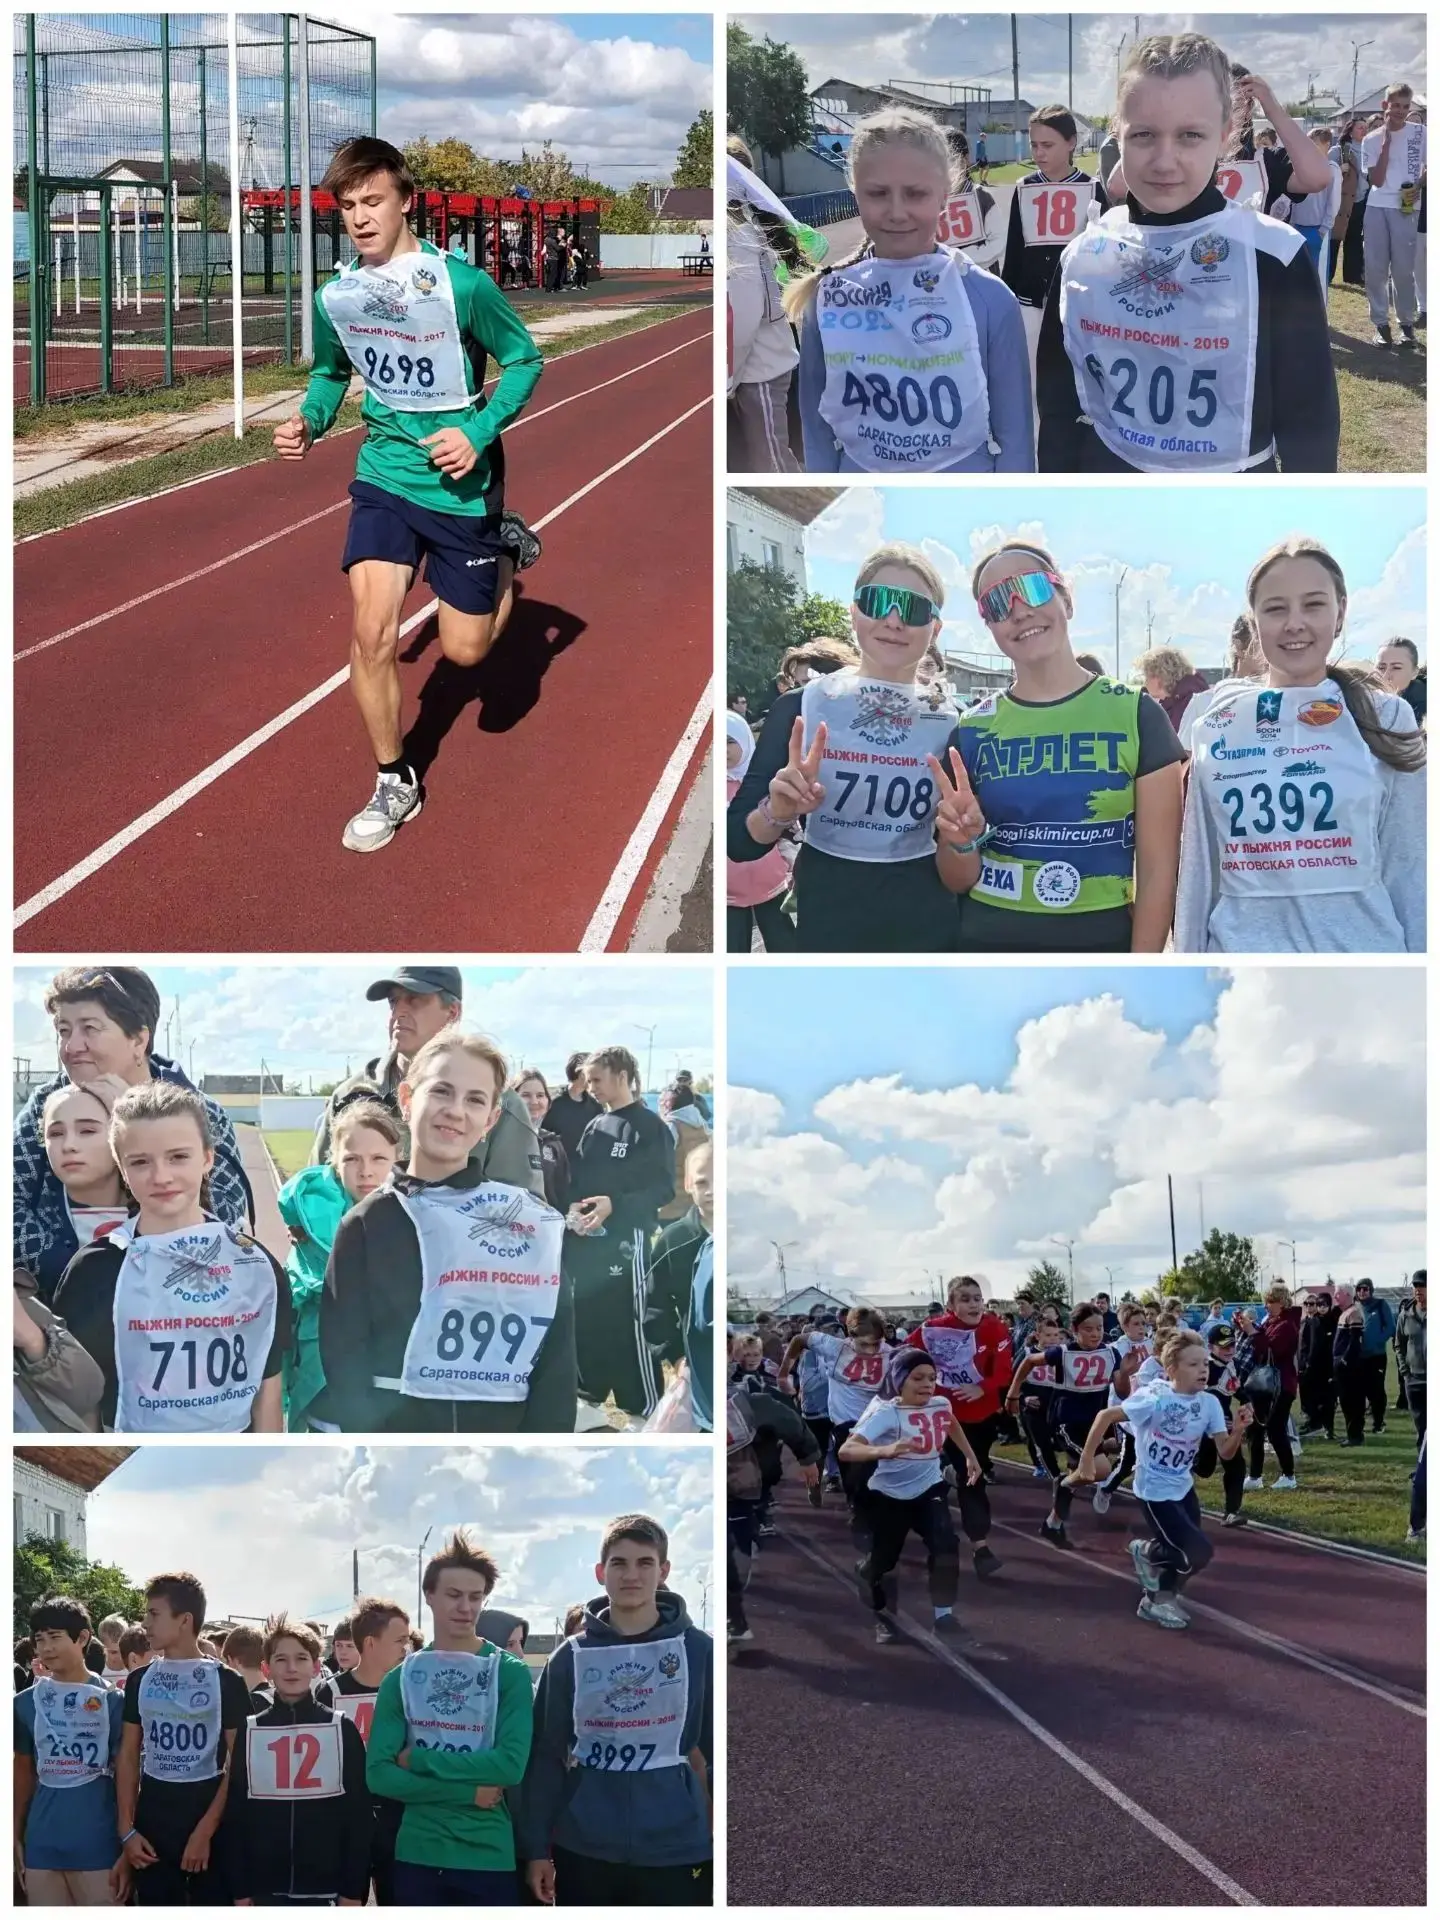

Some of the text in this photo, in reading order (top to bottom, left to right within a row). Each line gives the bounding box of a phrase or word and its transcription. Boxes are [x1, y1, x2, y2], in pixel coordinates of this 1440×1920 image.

[1032, 189, 1077, 236] 18
[1118, 297, 1175, 319] РОССИИ
[384, 329, 416, 343] РОССИИ
[423, 331, 446, 342] 2017
[1124, 329, 1180, 347] РОССИИ
[1193, 337, 1230, 350] 2019
[364, 346, 435, 388] 9698
[842, 370, 963, 430] 4800
[857, 424, 952, 448] САРАТОВСКАЯ
[1160, 436, 1217, 453] область
[873, 444, 931, 462] ОБЛАСТЬ
[858, 730, 909, 747] РОССИИ
[975, 731, 1129, 785] АТЛЕТ
[1291, 744, 1333, 755] TOYOTA
[871, 755, 918, 768] РОССИИ
[833, 770, 933, 821] 7108
[1222, 781, 1338, 837] 2392
[1242, 841, 1292, 854] ЛЫЖНЯ
[1296, 836, 1352, 850] РОССИИ
[1298, 856, 1358, 868] ОБЛАСТЬ
[479, 1239, 531, 1259] РОССИИ
[438, 1269, 488, 1287] ЛЫЖНЯ
[492, 1271, 540, 1286] РОССИИ
[173, 1283, 230, 1303] РОССИИ
[128, 1317, 182, 1331] ЛЫЖНЯ
[150, 1333, 248, 1392] 7108
[842, 1354, 883, 1385] 49
[1072, 1355, 1109, 1387] 22
[419, 1366, 510, 1383] Саратовская
[138, 1395, 219, 1411] Саратовская
[908, 1411, 952, 1455] 36
[615, 1719, 650, 1729] РОССИИ
[150, 1720, 208, 1752] 4800
[267, 1733, 322, 1789] 12
